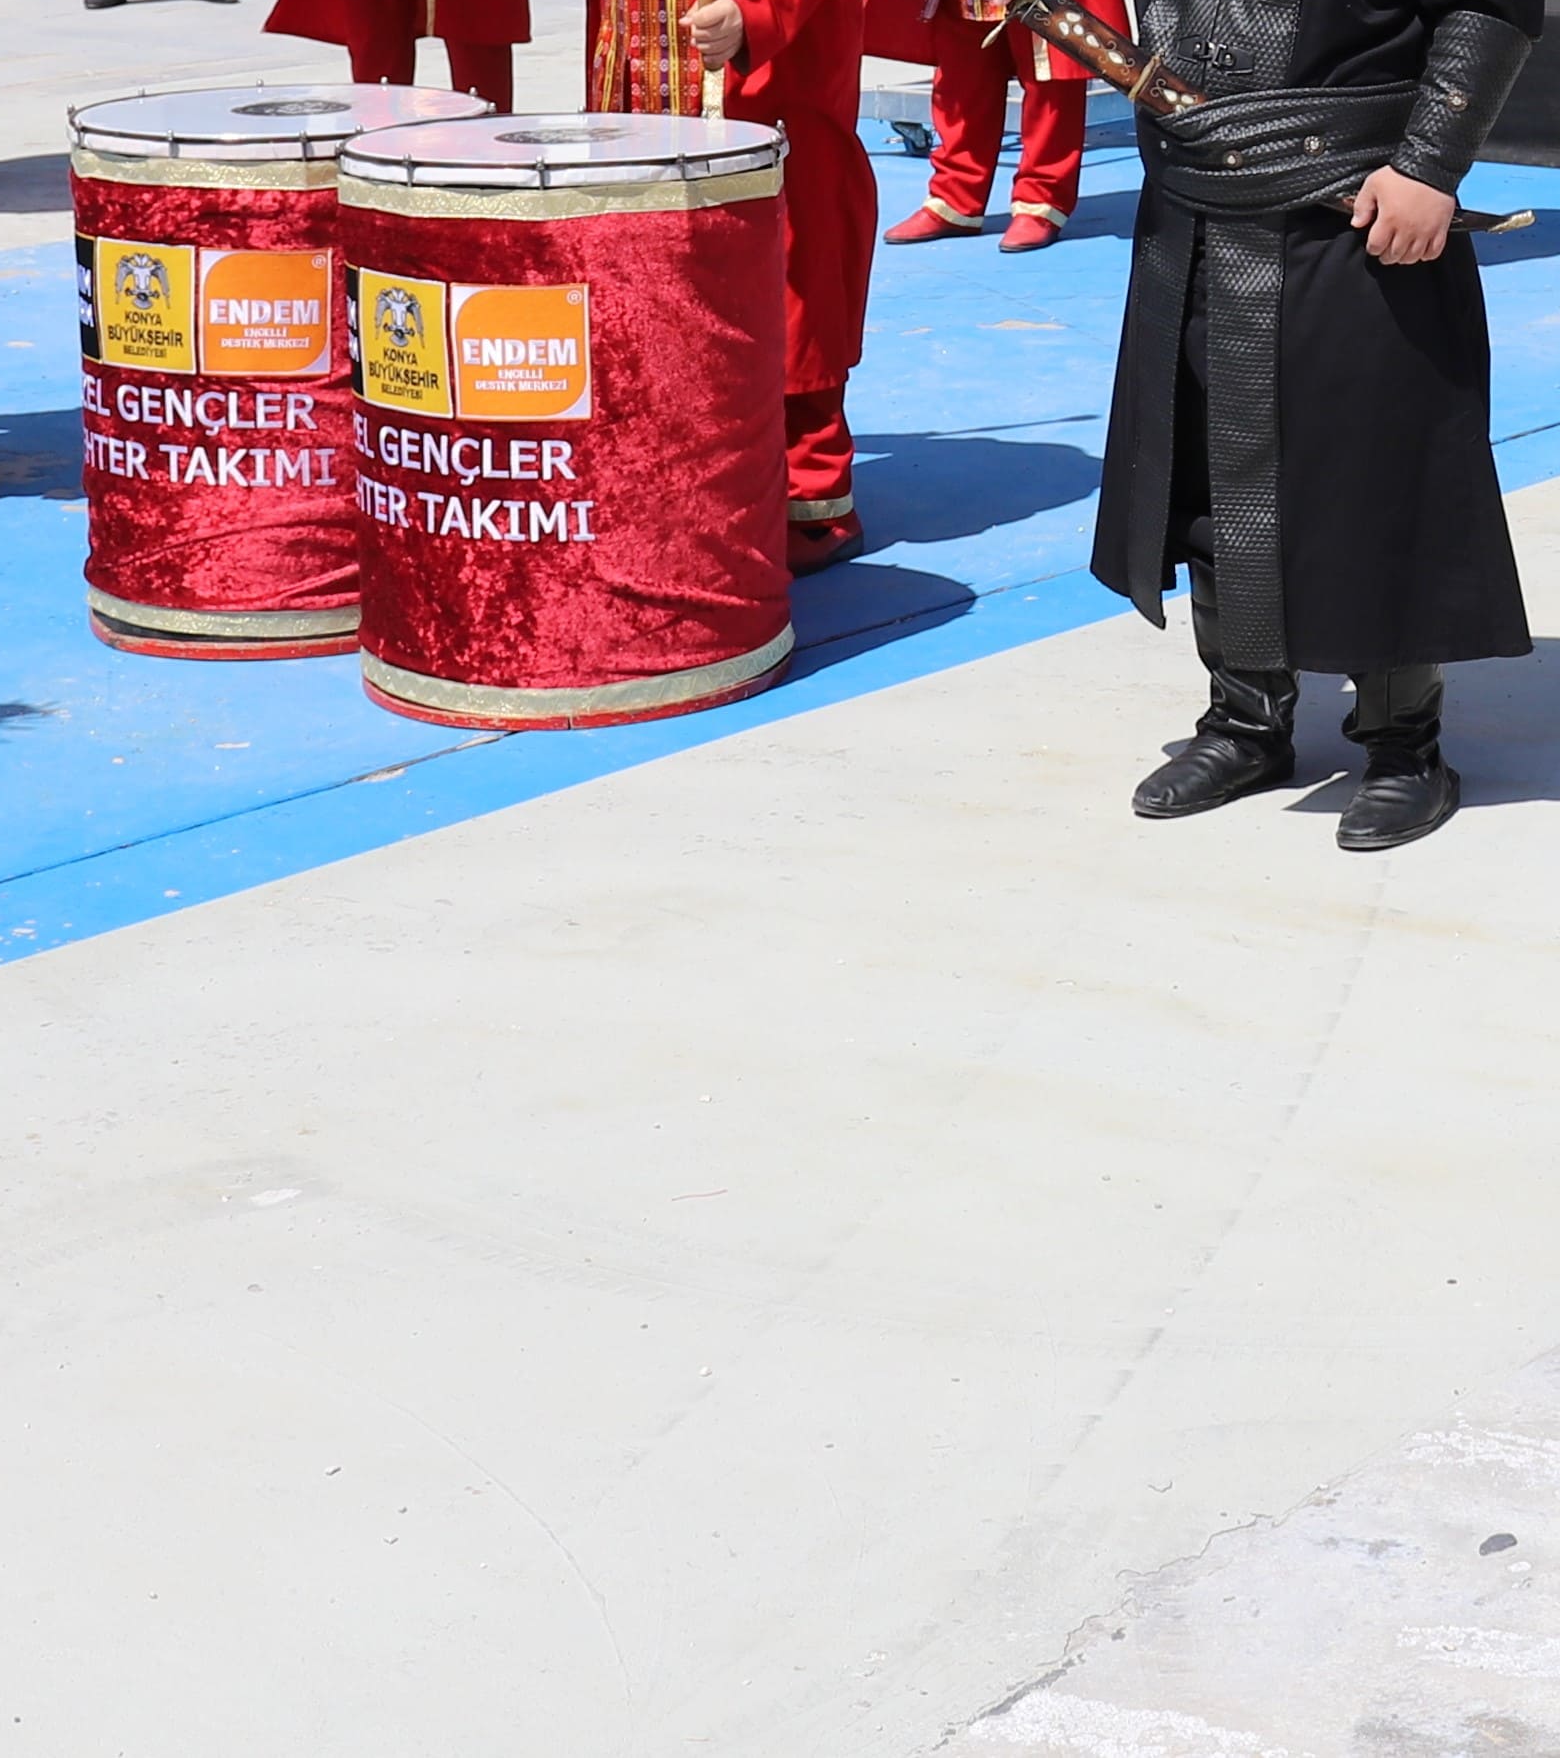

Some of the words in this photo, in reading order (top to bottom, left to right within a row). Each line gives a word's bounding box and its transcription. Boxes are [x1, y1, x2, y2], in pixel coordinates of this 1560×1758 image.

[124, 311, 162, 326] KONYA
[208, 298, 320, 325] ENDEM
[107, 325, 184, 347] BÜYÜKŞEHİR
[383, 347, 418, 365] KONYA
[462, 337, 578, 367] ENDEM
[368, 361, 440, 390] BÜYÜKŞEHİR
[116, 384, 318, 437] GENÇLER
[159, 443, 337, 487] TAKIMI
[379, 425, 577, 486] GENÇLER
[417, 492, 596, 543] TAKIMI
